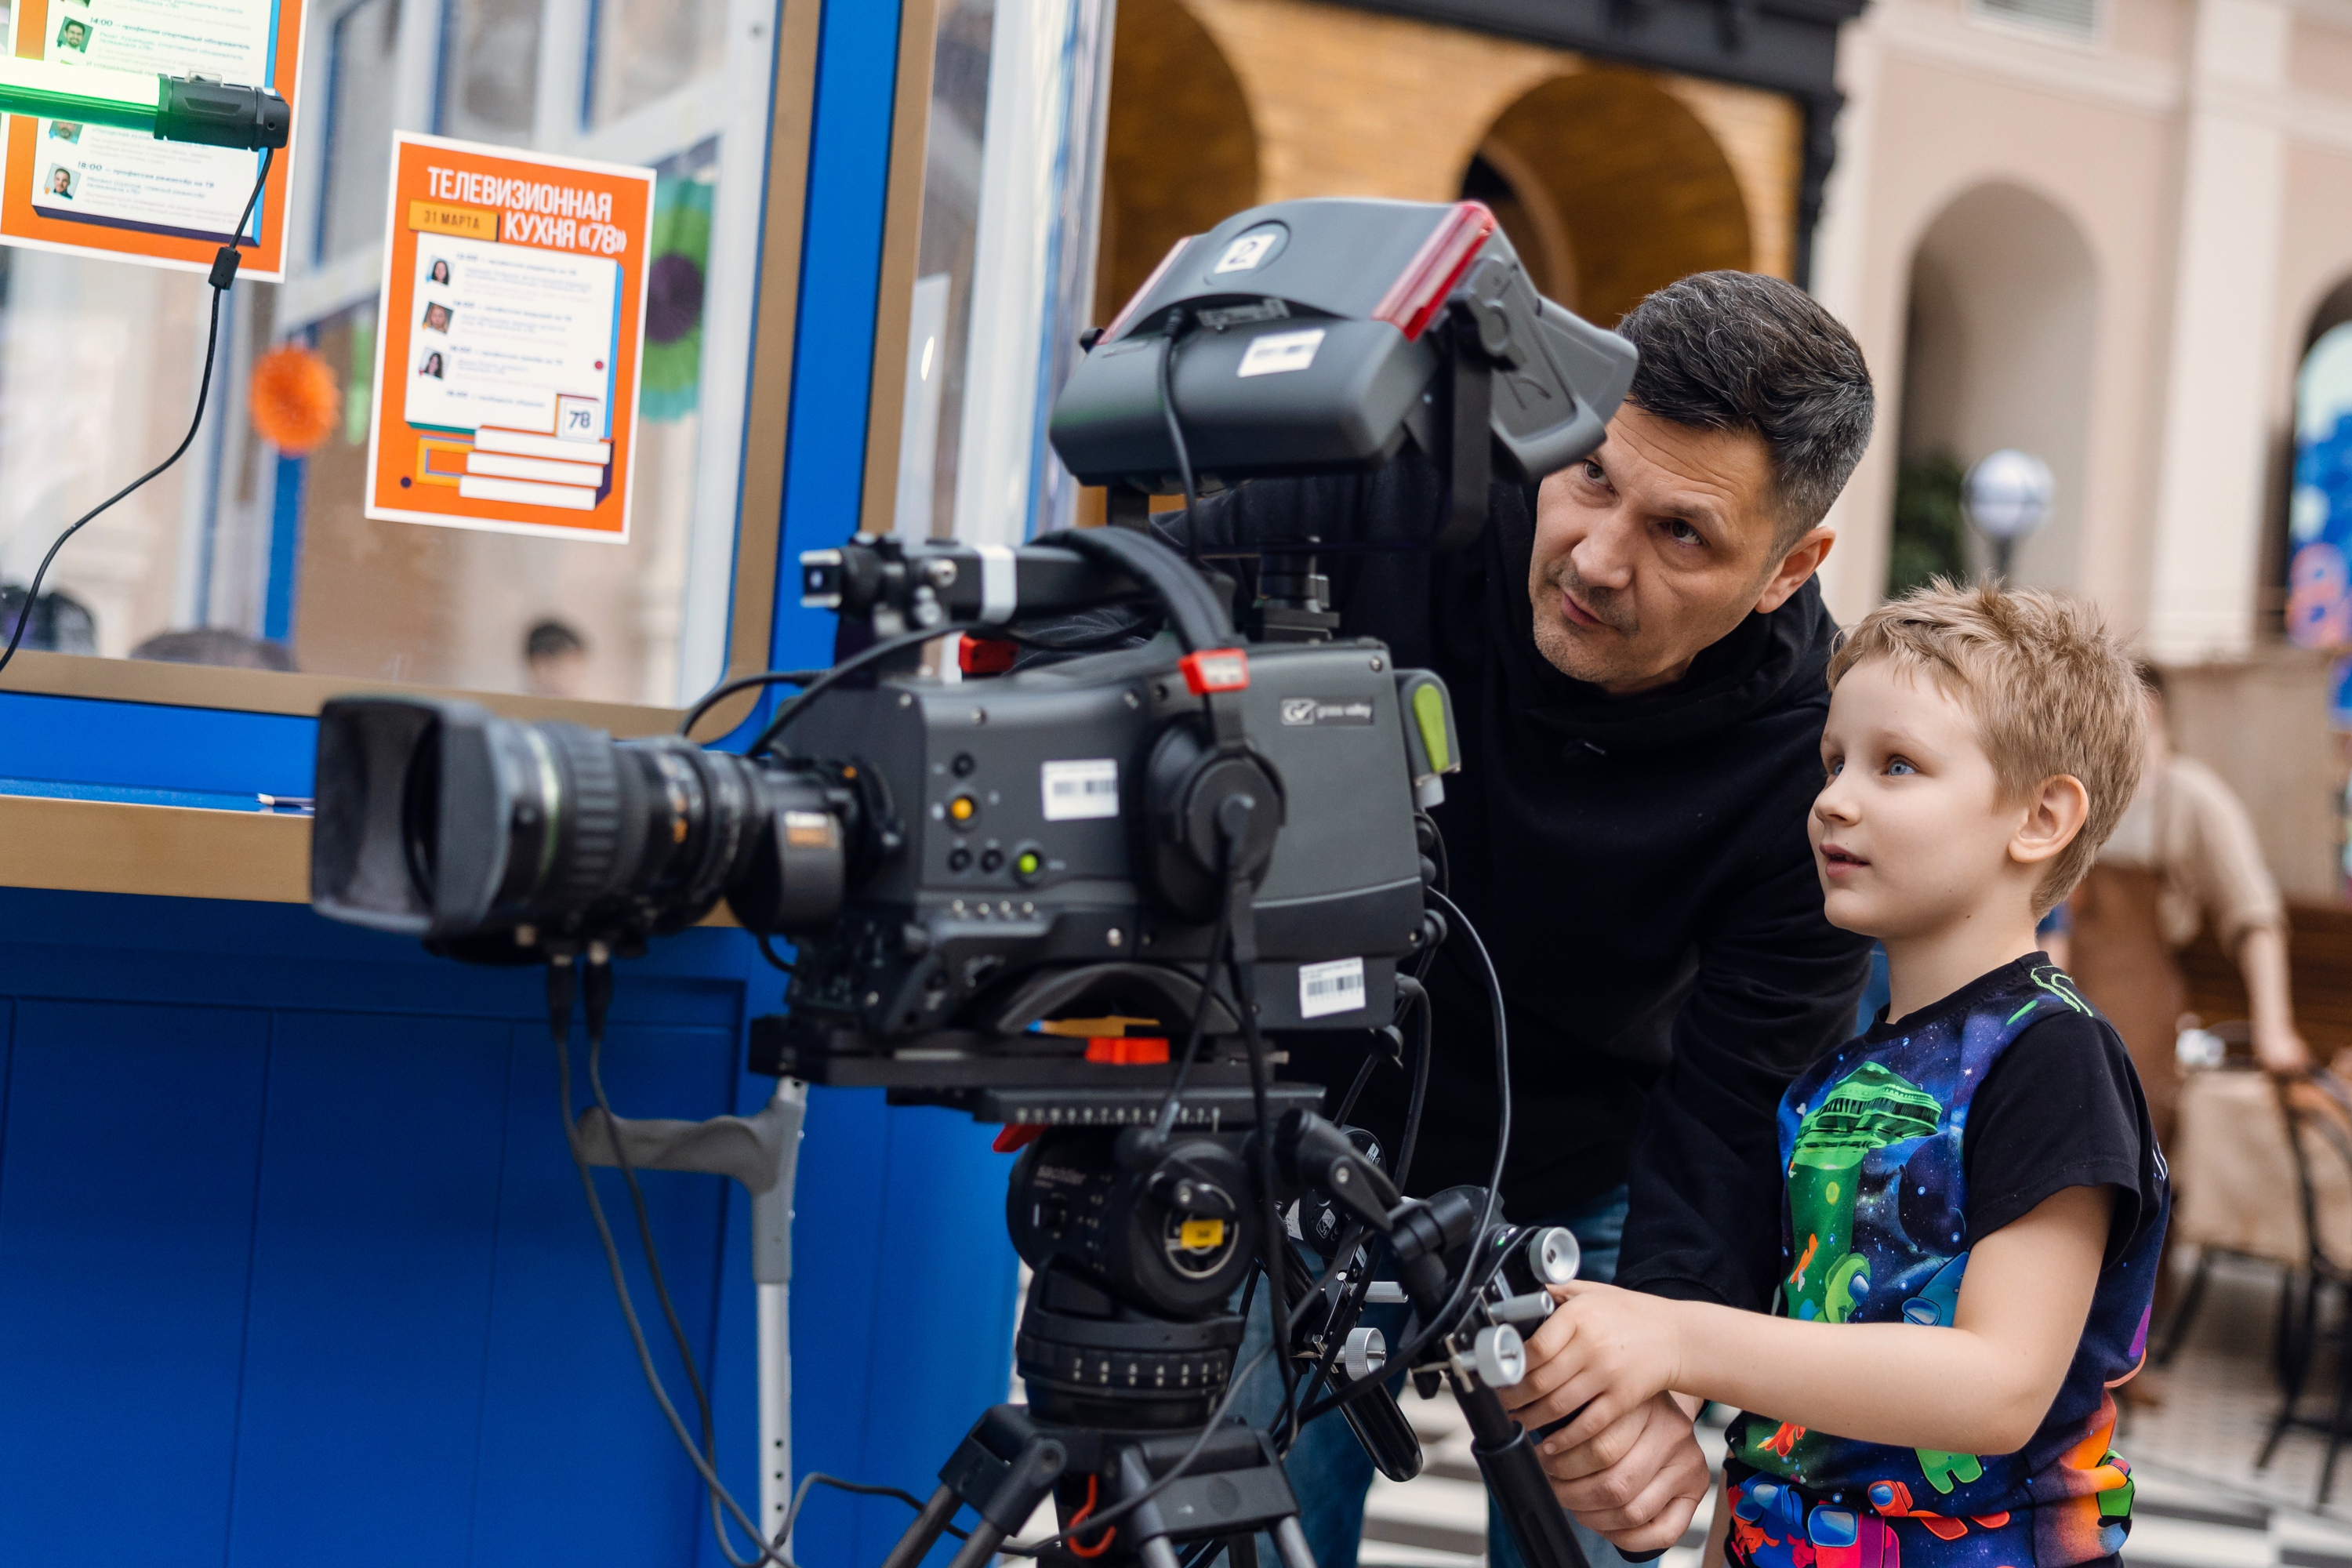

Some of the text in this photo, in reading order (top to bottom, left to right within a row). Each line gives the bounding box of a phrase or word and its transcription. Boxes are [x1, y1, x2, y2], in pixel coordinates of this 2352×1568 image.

[90, 17, 113, 27] 14:00
[122, 24, 161, 34] профессия
[78, 161, 102, 172] 18:00
[113, 169, 154, 180] профессия
[427, 165, 612, 223] ТЕЛЕВИЗИОННАЯ
[423, 210, 480, 229] 31 МАРТА
[504, 210, 627, 255] КУХНЯ «78»
[1228, 241, 1258, 264] 2
[569, 410, 590, 429] 78
